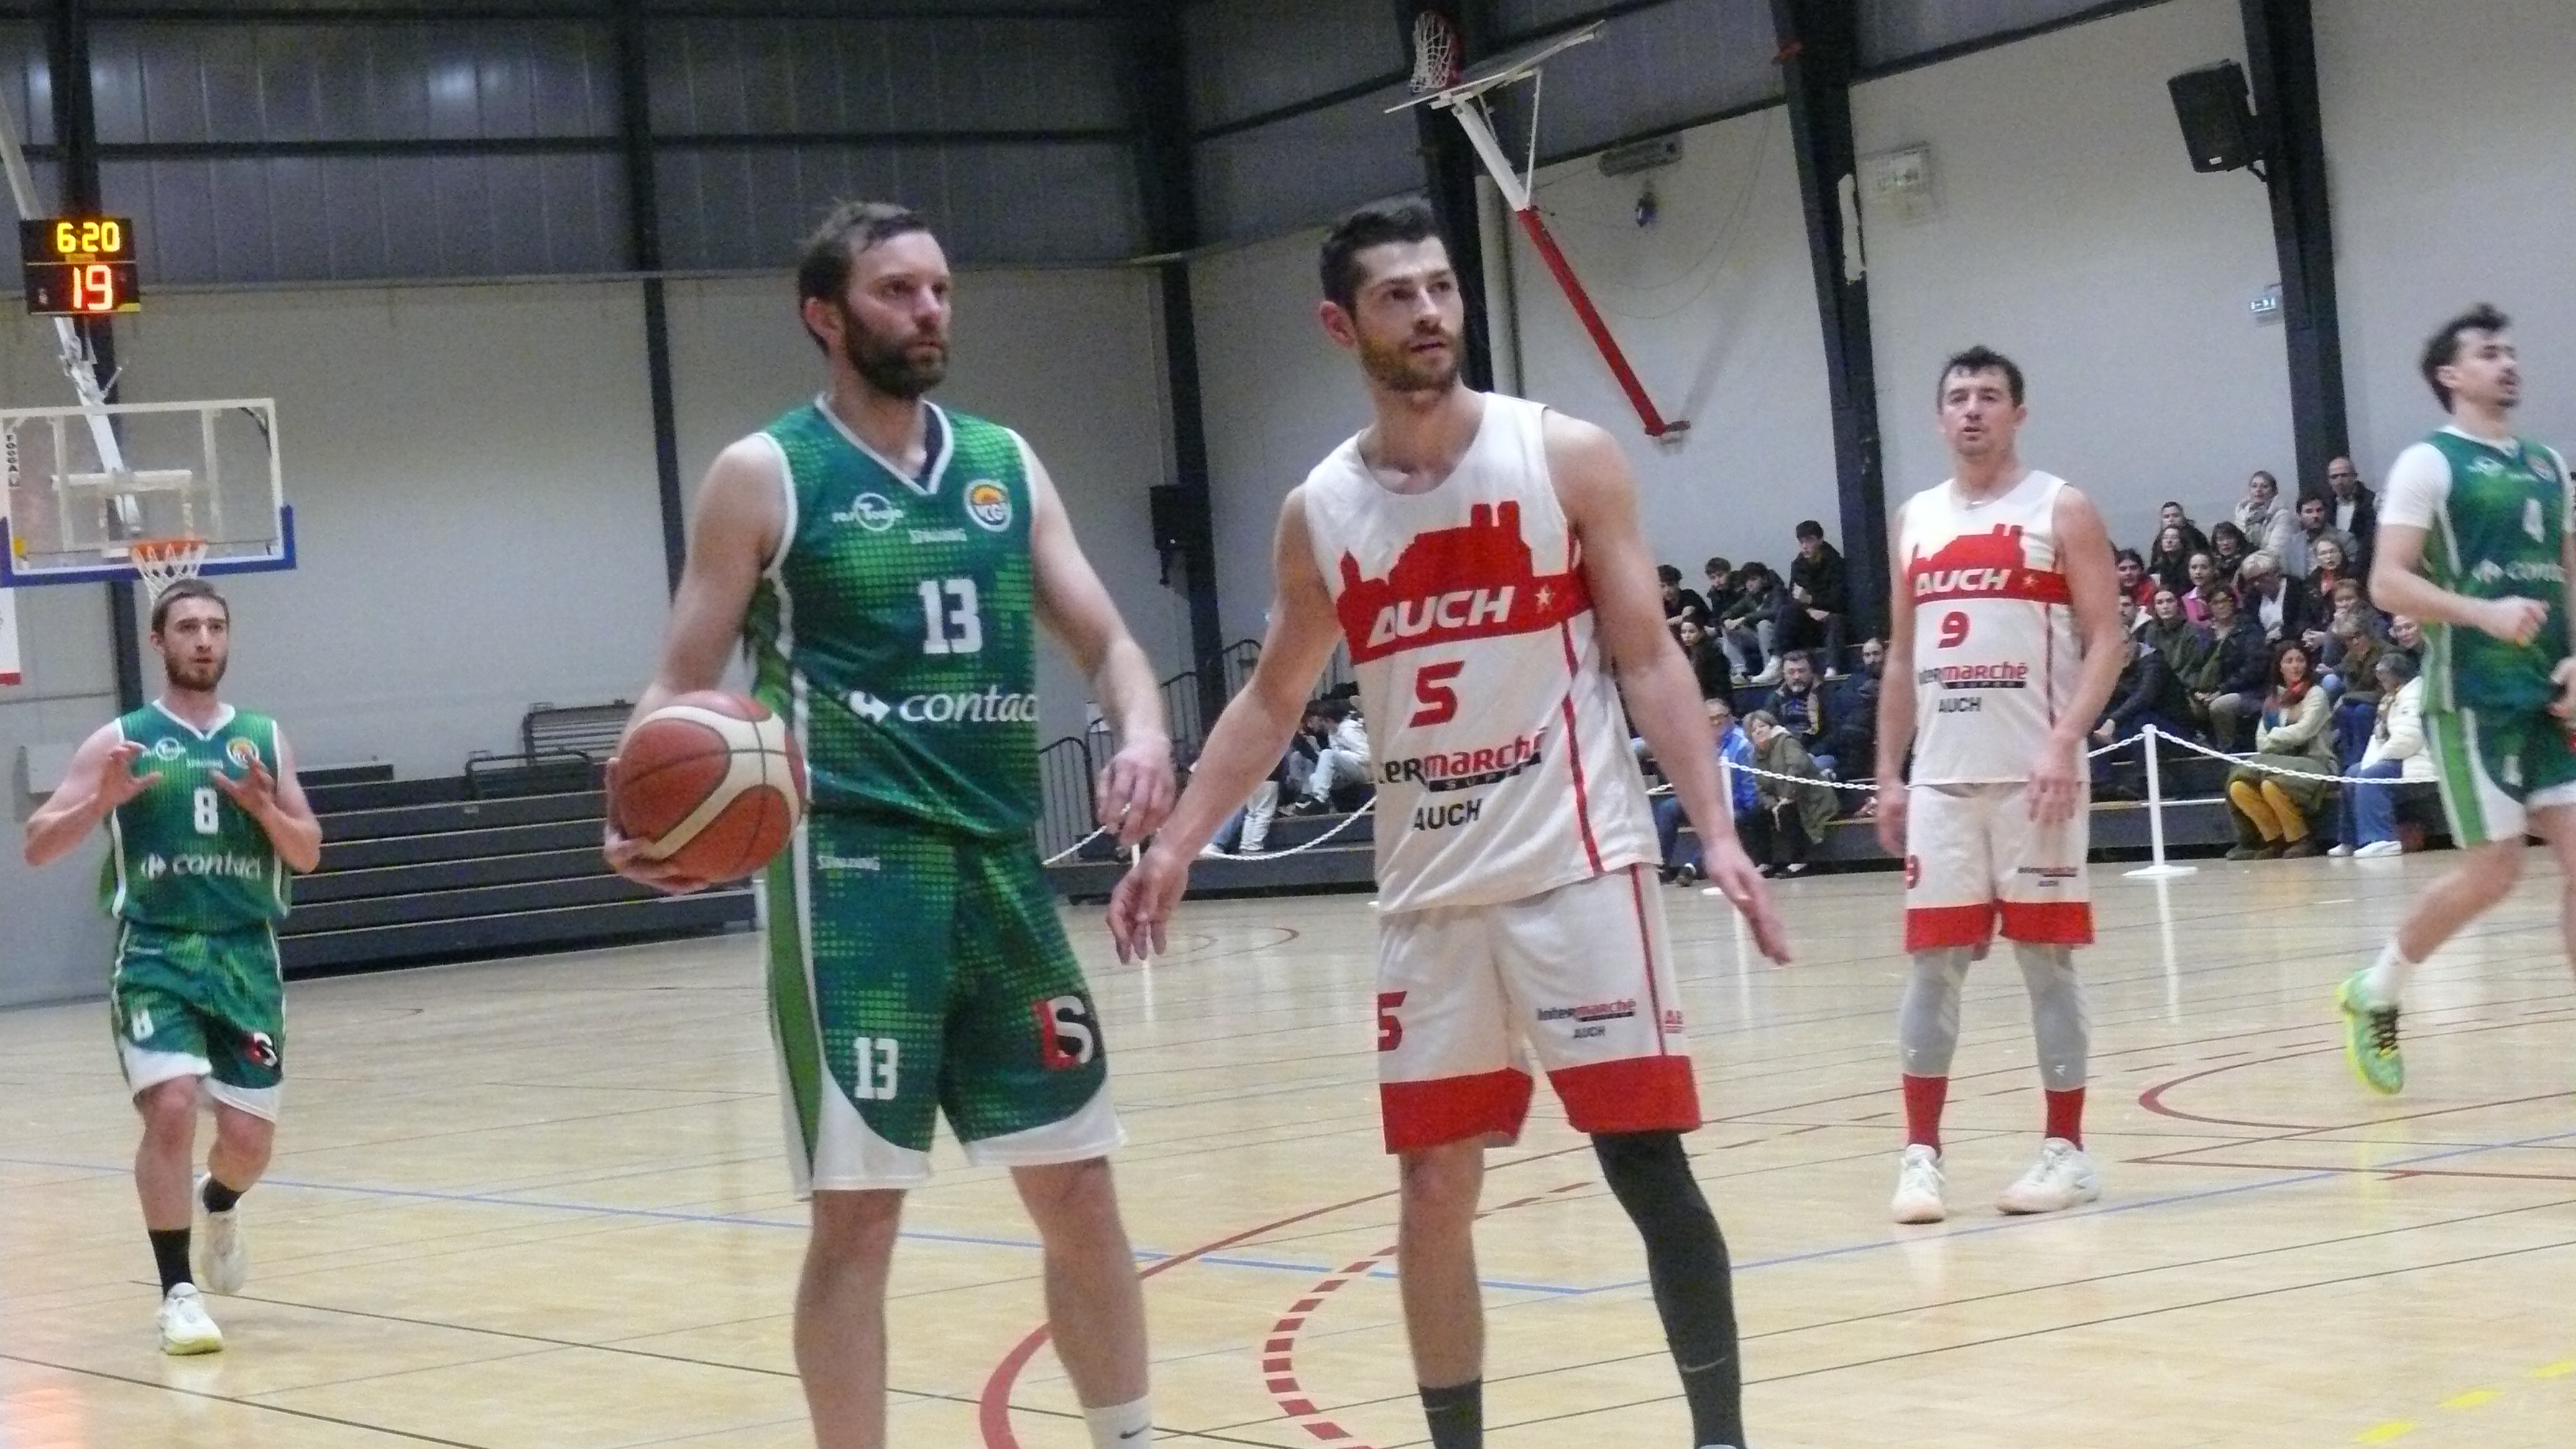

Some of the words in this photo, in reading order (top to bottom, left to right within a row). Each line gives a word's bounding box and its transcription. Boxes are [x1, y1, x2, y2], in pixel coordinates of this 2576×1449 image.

[73, 265, 112, 310] 19
[1915, 568, 2012, 597] AUCH
[919, 579, 983, 654] 13
[1366, 586, 1516, 648] AUCH
[1938, 611, 1969, 648] 9
[898, 684, 1039, 722] contac
[1409, 661, 1465, 728] 5
[194, 788, 218, 834] 8
[1413, 799, 1484, 832] AUCH
[1378, 990, 1407, 1052] 5
[855, 1036, 899, 1100] 13
